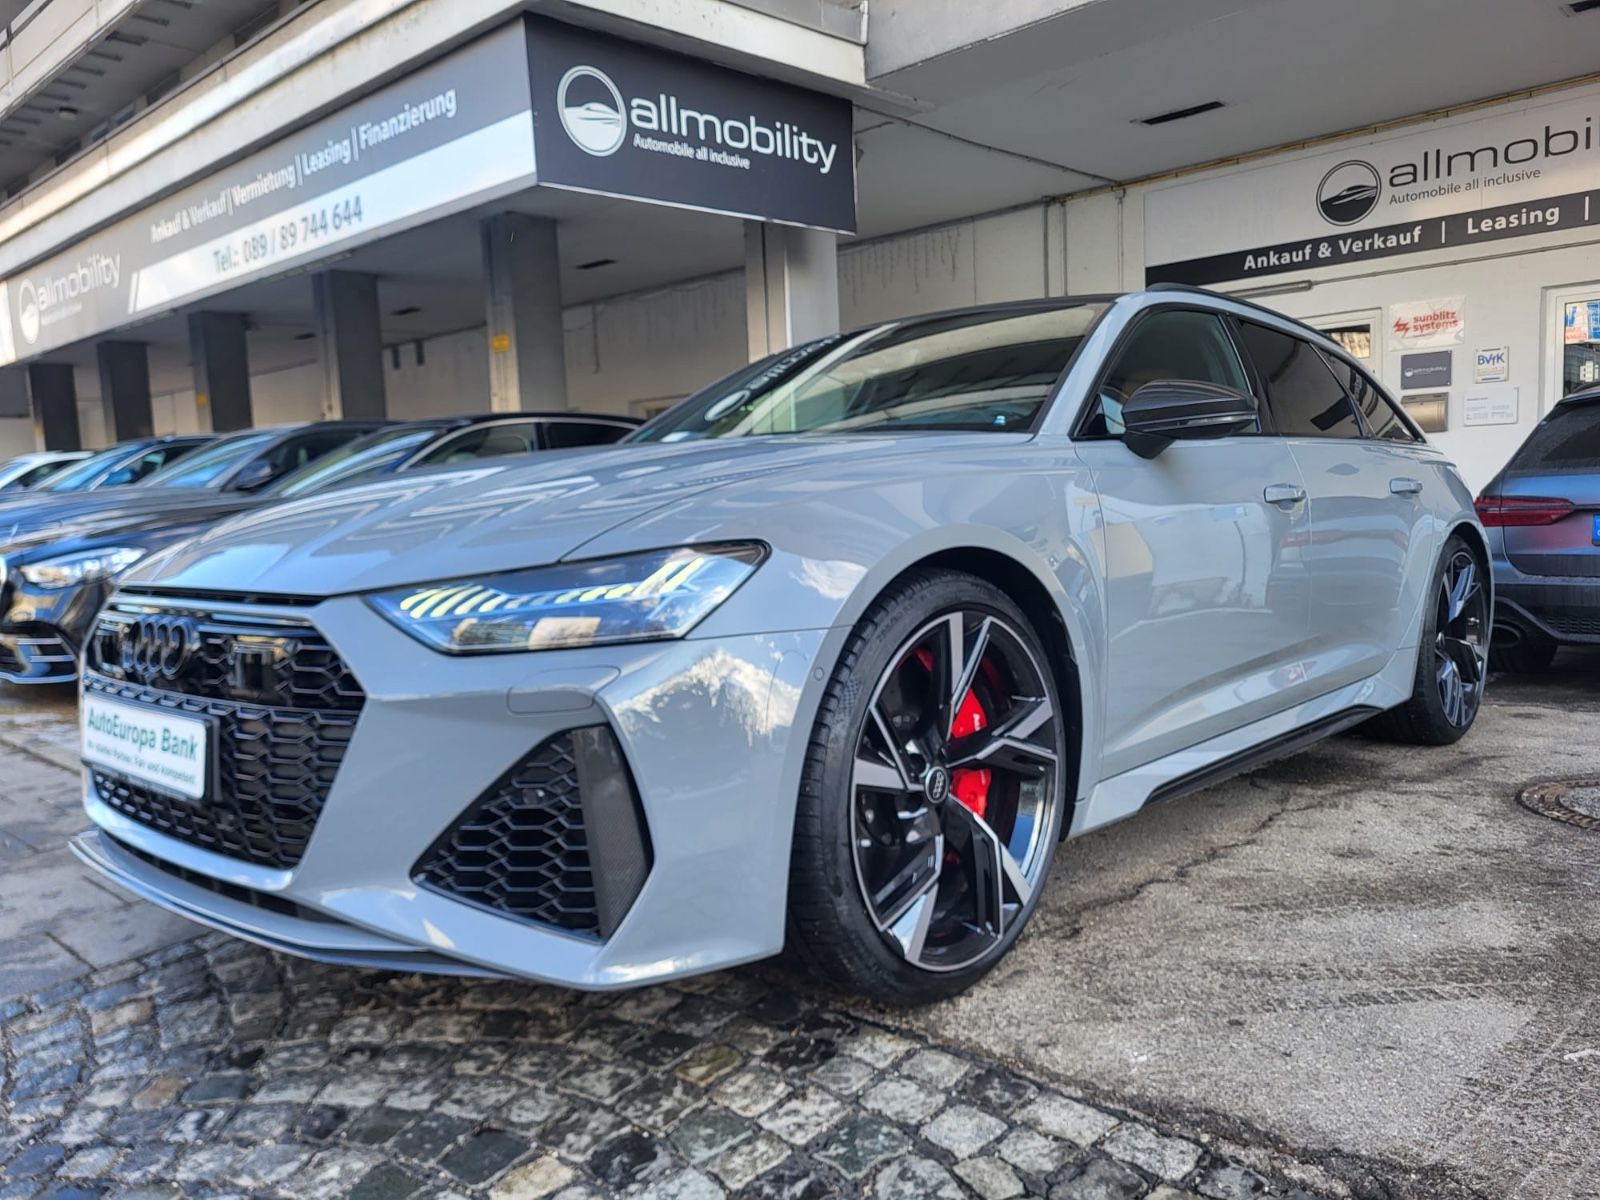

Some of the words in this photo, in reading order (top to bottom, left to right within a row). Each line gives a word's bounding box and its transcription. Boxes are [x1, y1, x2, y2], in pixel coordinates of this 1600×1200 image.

[232, 165, 296, 206] Vermietung
[301, 139, 351, 175] Leasing
[358, 88, 457, 149] Finanzierung
[630, 93, 837, 174] allmobility
[633, 133, 695, 159] Automobile
[695, 146, 709, 161] all
[709, 149, 751, 169] inclusive
[1389, 117, 1600, 188] allmobi
[1389, 183, 1462, 205] Automobile
[1465, 179, 1480, 191] all
[1483, 169, 1542, 187] inclusive
[243, 234, 268, 263] 089
[280, 222, 298, 251] 89
[301, 209, 328, 238] 744
[332, 195, 363, 231] 644
[1243, 246, 1312, 271] Ankauf
[1317, 242, 1332, 259] &
[1338, 226, 1422, 255] Verkauf
[1466, 205, 1560, 235] Leasing
[38, 252, 121, 312] allmobility
[1413, 310, 1457, 323] sunblitz
[1413, 319, 1458, 333] systems
[87, 707, 157, 751] AutoEuropa
[161, 727, 199, 762] Bank
